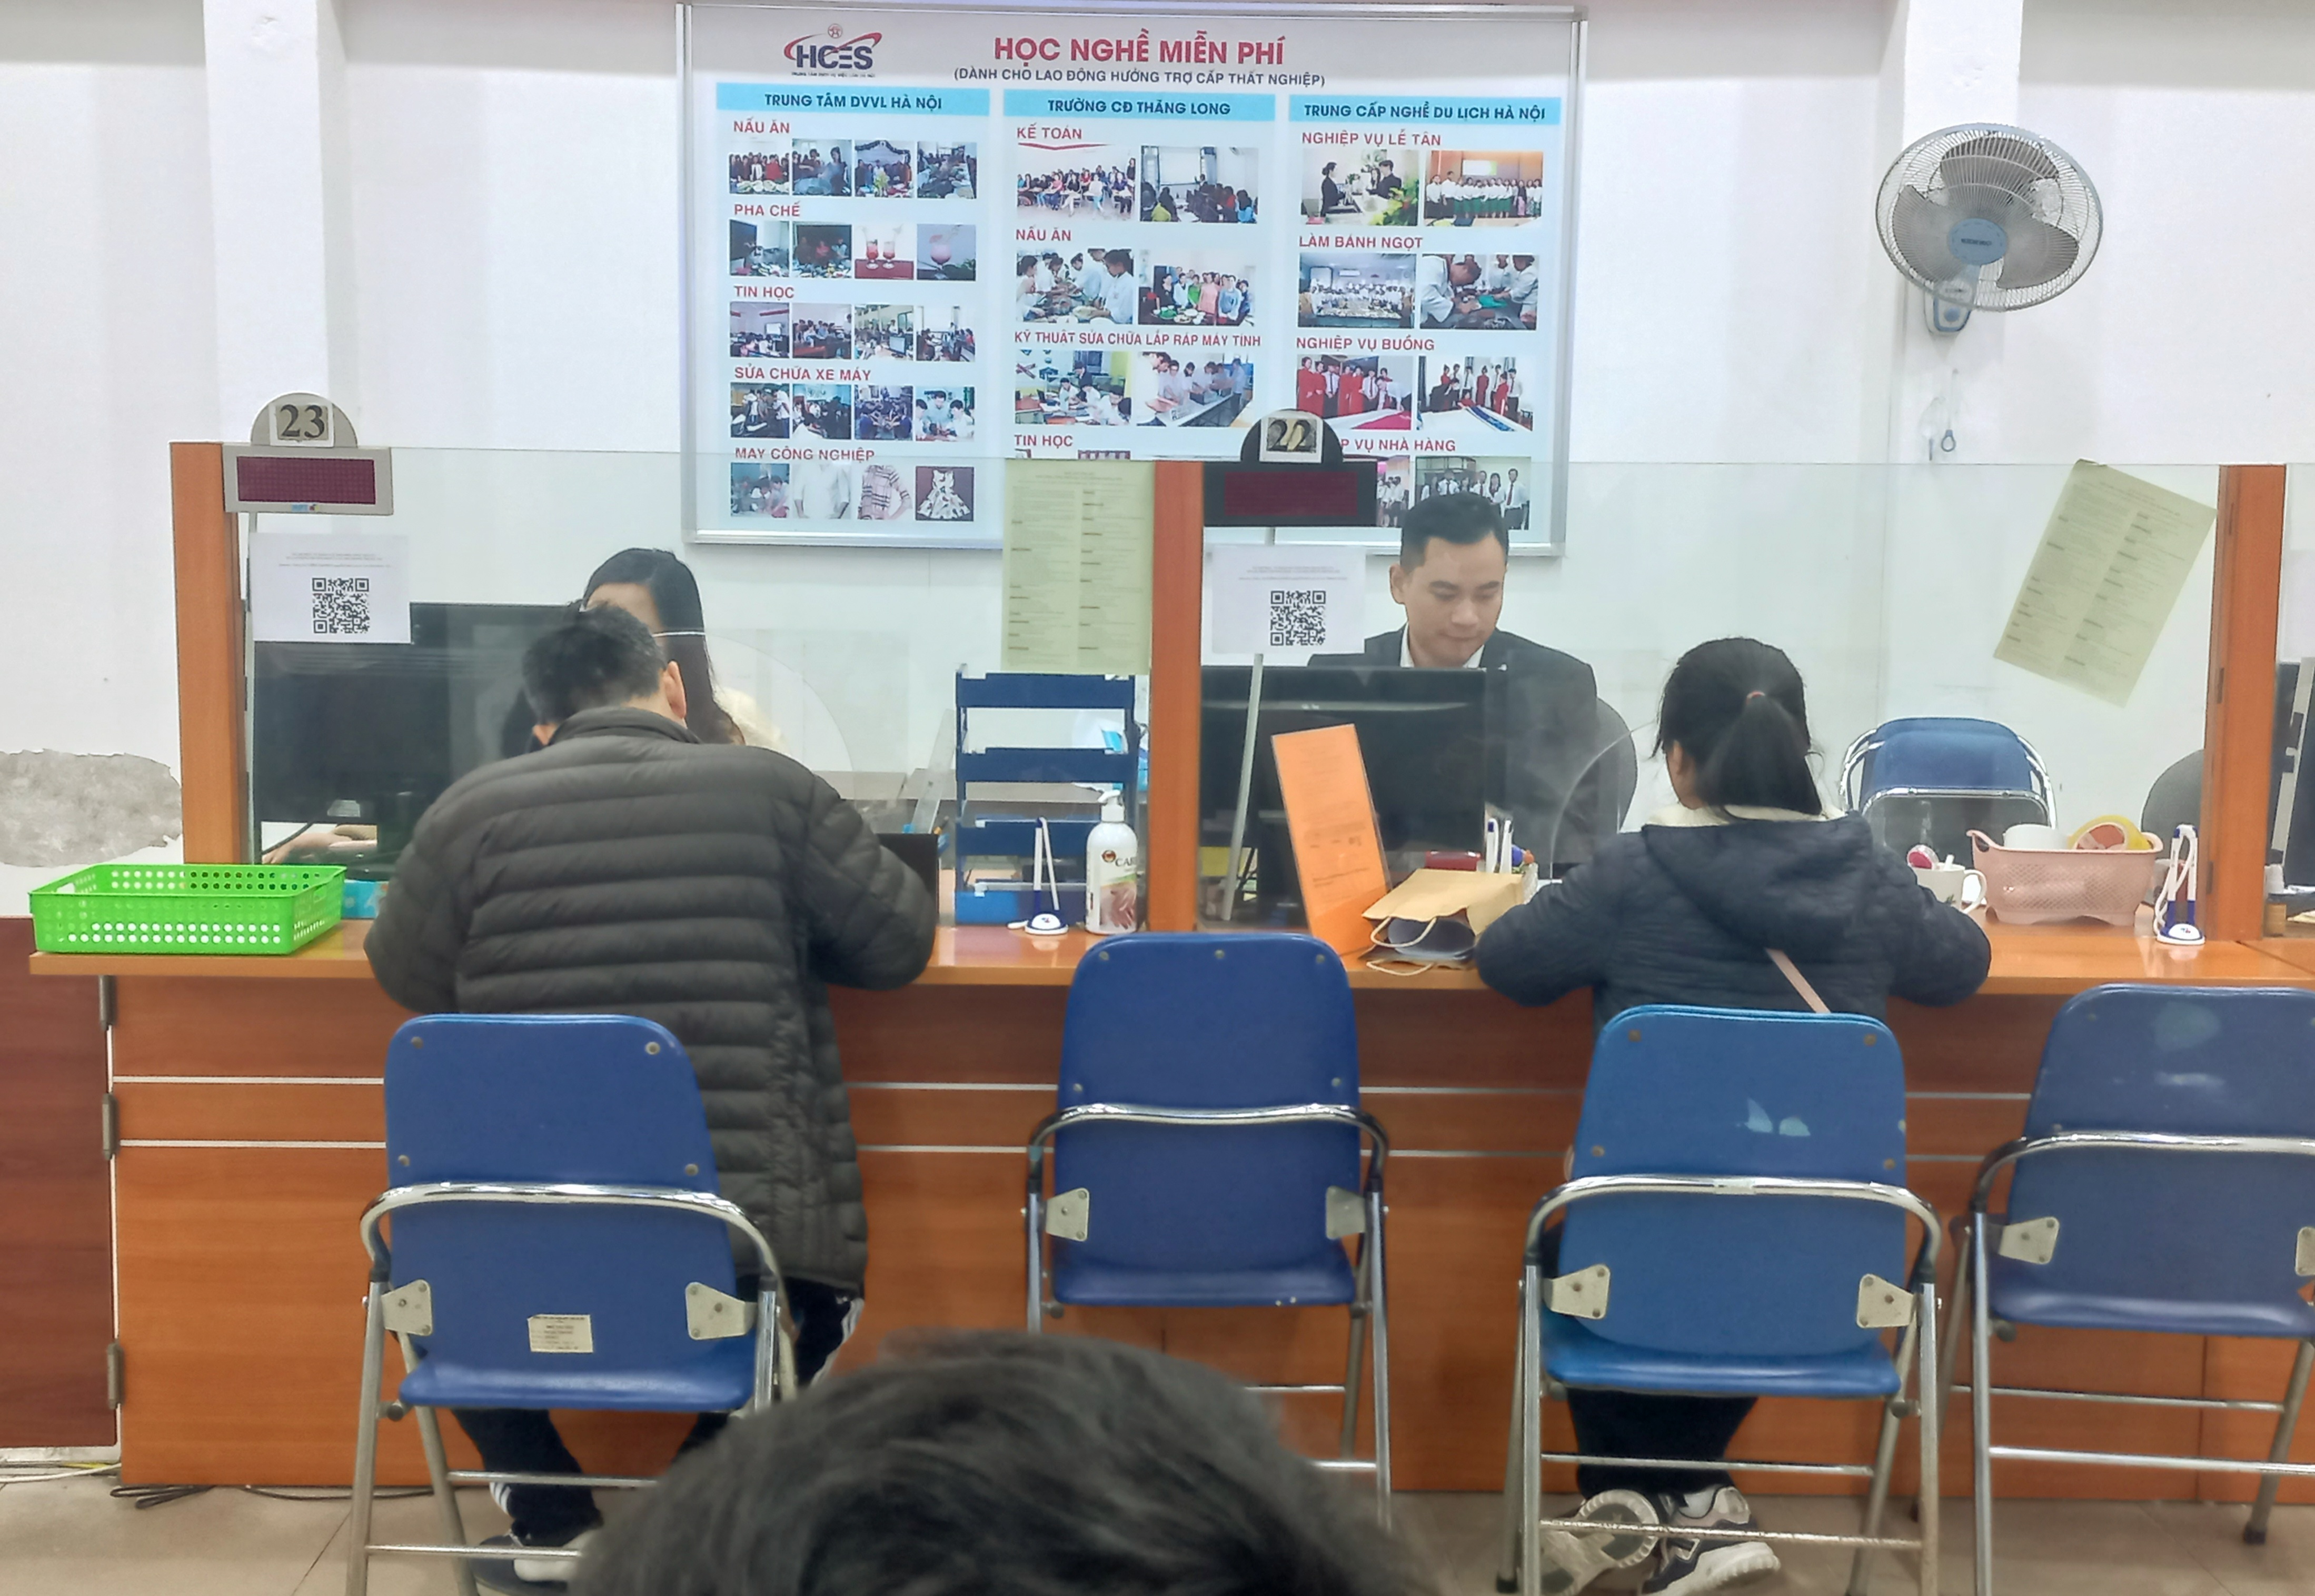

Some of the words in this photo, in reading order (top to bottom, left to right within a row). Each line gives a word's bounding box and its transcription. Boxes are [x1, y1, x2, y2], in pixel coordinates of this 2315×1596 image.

[995, 37, 1060, 67] HỌC
[1071, 28, 1149, 62] NGHỀ
[1160, 31, 1227, 64] MIỄN
[1238, 36, 1285, 64] PHÍ
[796, 45, 873, 71] HCES
[955, 66, 997, 80] (DÀNH
[1002, 69, 1031, 80] CHO
[1036, 70, 1062, 81] LAO
[1067, 67, 1106, 82] ĐỘNG
[1196, 69, 1224, 84] CẤP
[1268, 72, 1325, 87] NGHIỆP)
[765, 94, 812, 106] TRUNG
[851, 96, 887, 108] DVVL
[891, 94, 911, 108] HÀ
[916, 95, 941, 111] NỘI
[1048, 98, 1106, 112] TRƯỜNG
[1111, 102, 1132, 113] CĐ
[1191, 103, 1230, 114] LONG
[1305, 105, 1351, 116] TRUNG
[1356, 102, 1386, 117] CẤP
[1390, 101, 1429, 118] NGHỀ
[1434, 107, 1453, 118] DU
[1458, 107, 1489, 119] LỊCH
[1495, 105, 1516, 119] HÀ
[1519, 105, 1545, 122] NỘI
[734, 118, 764, 133] NẤU
[770, 120, 789, 133] ĂN
[1017, 123, 1036, 138] KẾ
[1042, 126, 1081, 139] TOÁN
[1303, 130, 1358, 146] NGHIỆP
[1364, 133, 1386, 146] VỤ
[1412, 132, 1440, 146] TÂN
[734, 204, 764, 215] PHA
[770, 202, 800, 216] CHẾ
[1016, 226, 1046, 241] NẤU
[1051, 227, 1071, 241] ĂN
[1299, 233, 1329, 247] LÀM
[1335, 235, 1376, 248] BÁNH
[1382, 237, 1423, 251] NGỌT
[734, 286, 757, 297] TIN
[763, 287, 794, 301] HỌC
[1203, 335, 1227, 346] MÁY
[1297, 335, 1352, 351] NGHIỆP
[1358, 338, 1376, 352] VỤ
[816, 369, 834, 380] XE
[840, 367, 871, 381] MÁY
[280, 404, 325, 438] 23
[1014, 435, 1036, 446] TIN
[1042, 435, 1072, 448] HỌC
[1267, 419, 1315, 452] 22
[1355, 439, 1373, 451] VỤ
[1379, 437, 1408, 451] NHÀ
[1415, 437, 1455, 452] HÀNG
[736, 448, 765, 458] MAY
[771, 446, 813, 460] CÔNG
[819, 447, 875, 462] NGHIỆP
